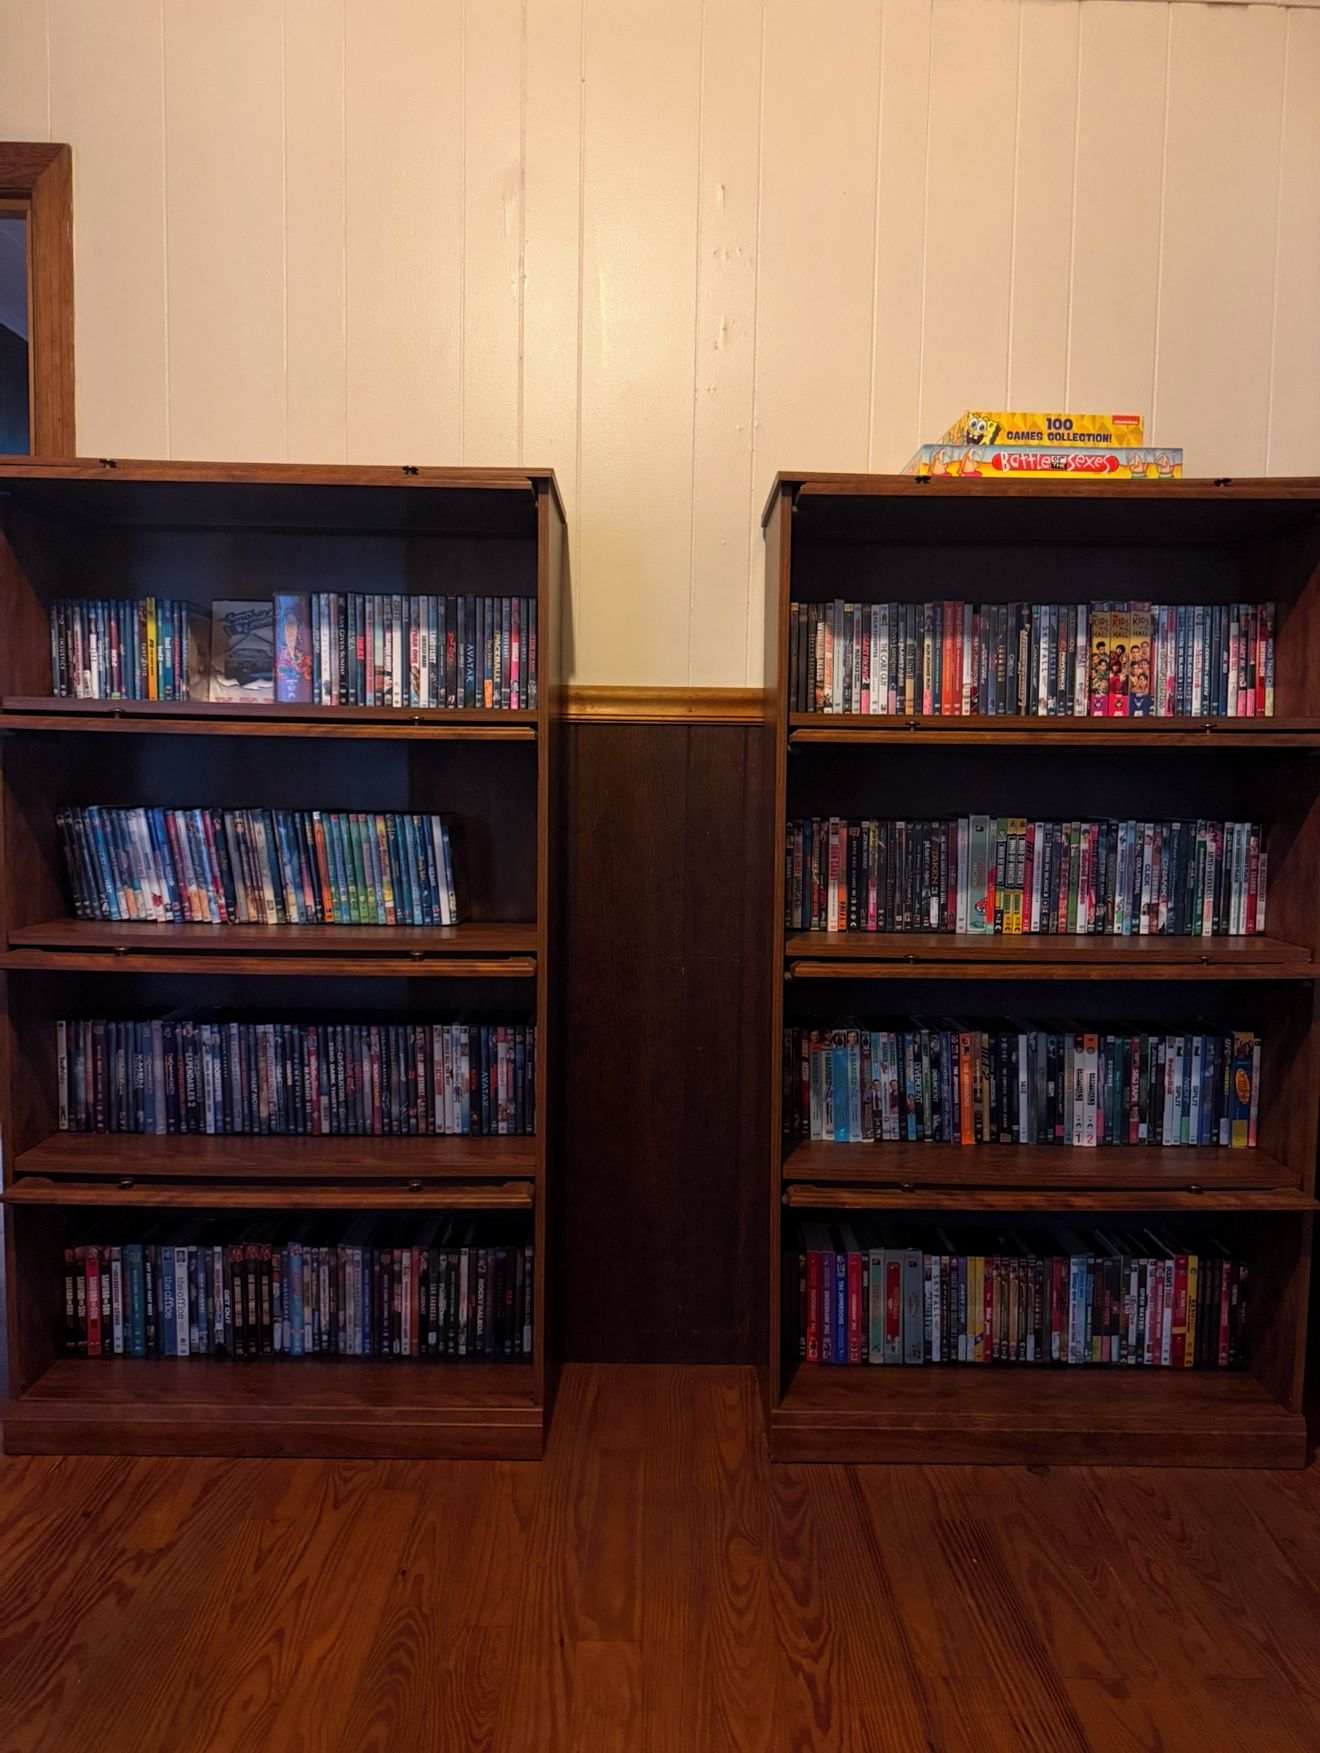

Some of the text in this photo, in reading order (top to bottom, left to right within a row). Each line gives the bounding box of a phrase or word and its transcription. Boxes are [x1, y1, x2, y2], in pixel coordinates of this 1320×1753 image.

[1046, 417, 1073, 431] 100
[1006, 432, 1112, 444] GAMES COLLECTION!
[1000, 452, 1051, 473] Battle
[1066, 454, 1111, 474] Sexes
[185, 1052, 194, 1098] EXPENDABLES
[1076, 1133, 1081, 1144] 1
[1087, 1134, 1094, 1144] 2
[164, 1276, 173, 1318] the office
[177, 1276, 186, 1320] the office
